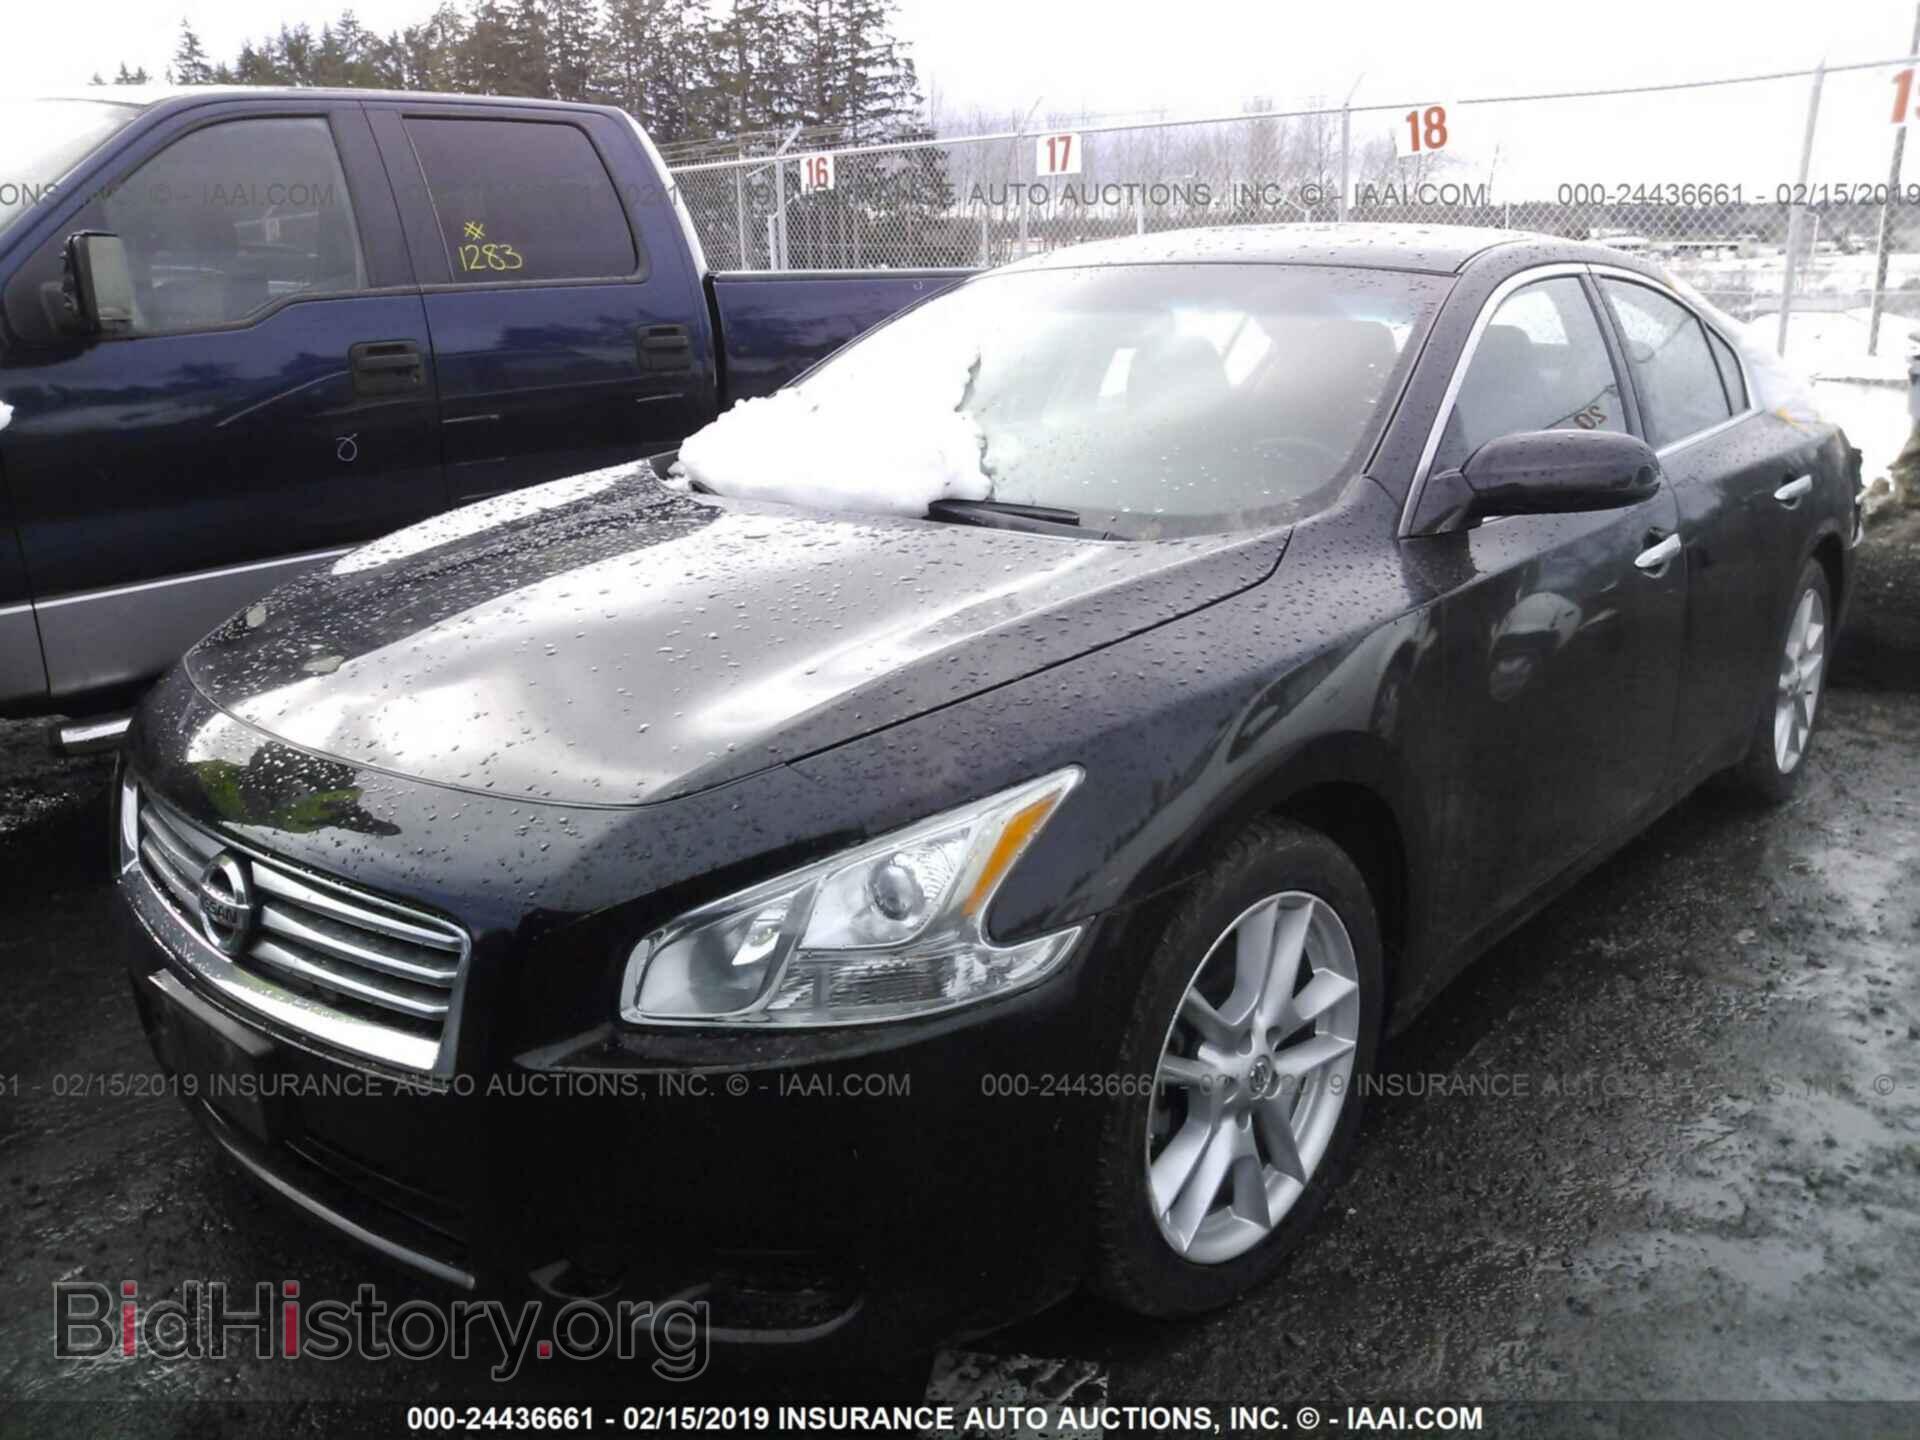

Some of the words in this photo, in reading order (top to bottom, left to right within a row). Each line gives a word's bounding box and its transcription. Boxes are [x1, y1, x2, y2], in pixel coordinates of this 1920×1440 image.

[1891, 69, 1920, 122] 1
[1406, 107, 1448, 151] 18
[805, 156, 831, 189] 16
[1046, 135, 1074, 174] 17
[458, 243, 524, 272] 1283
